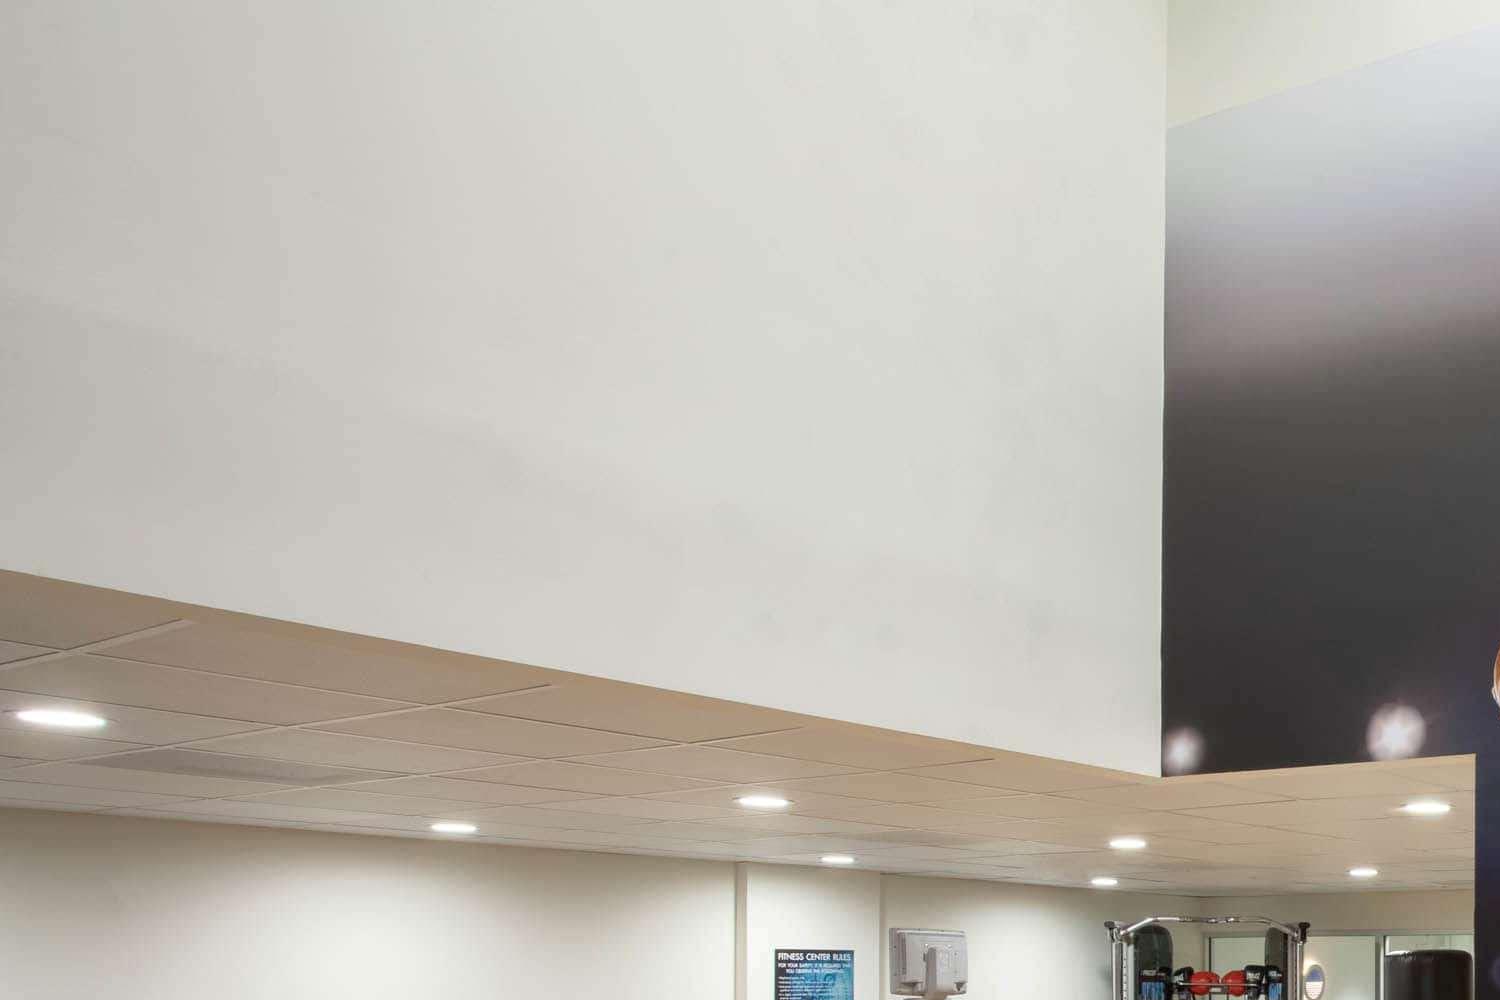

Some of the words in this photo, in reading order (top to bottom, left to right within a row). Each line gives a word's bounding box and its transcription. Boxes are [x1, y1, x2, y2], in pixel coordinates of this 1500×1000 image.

[777, 952, 804, 961] FITNESS
[805, 952, 831, 961] CENTER
[832, 953, 852, 961] RULES
